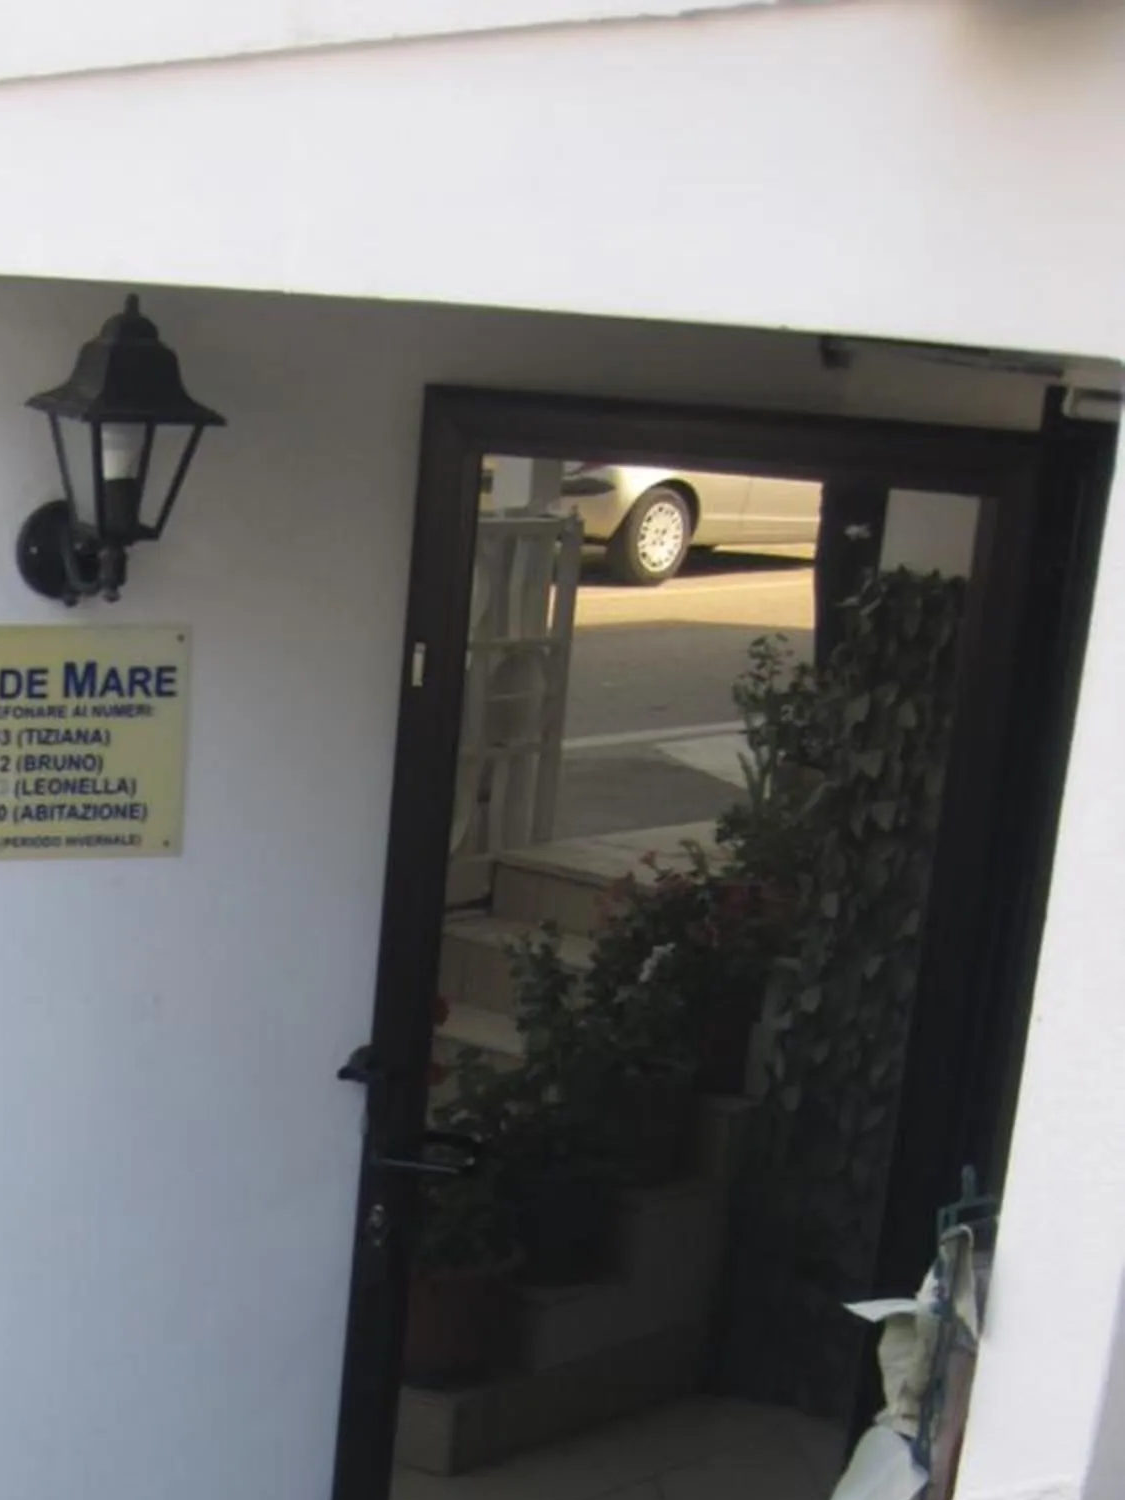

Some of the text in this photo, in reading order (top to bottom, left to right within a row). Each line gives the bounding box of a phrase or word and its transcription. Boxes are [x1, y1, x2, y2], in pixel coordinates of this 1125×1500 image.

[63, 661, 177, 698] MARE
[73, 705, 87, 718] AI
[17, 728, 111, 749] (TIZIANA)
[16, 754, 104, 776] (BRUNO)
[14, 777, 137, 799] (LEONELLA)
[12, 802, 149, 824] (ABITAZIONE)
